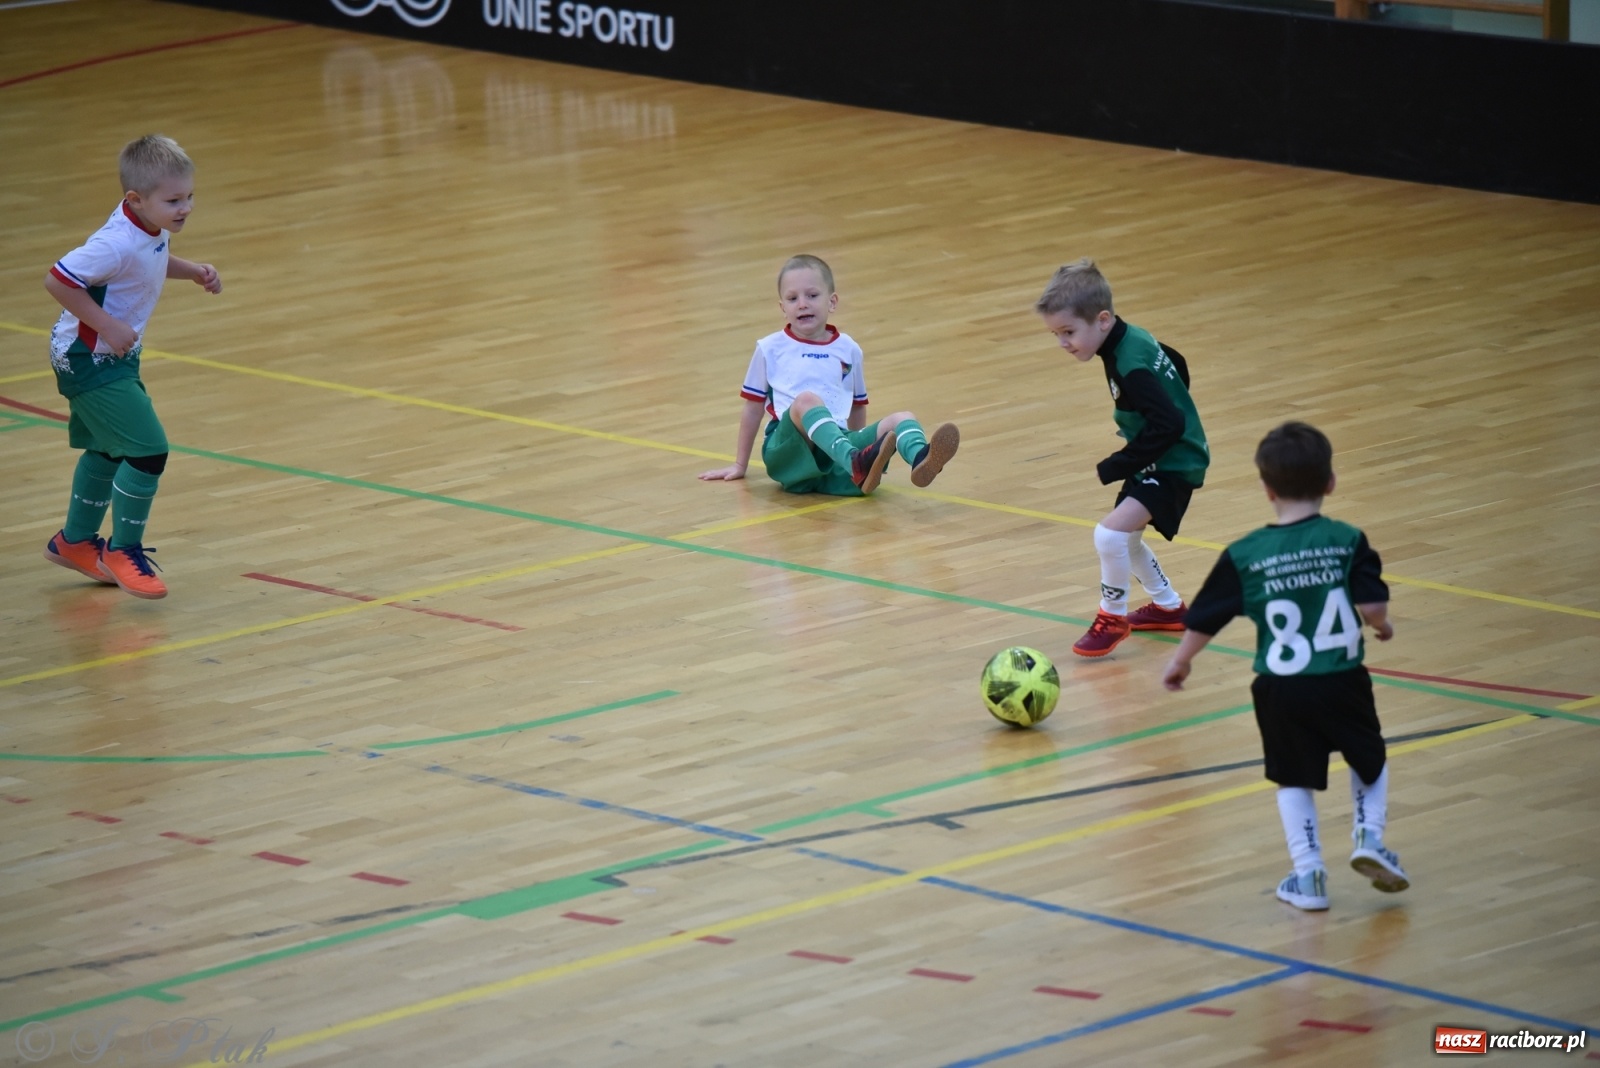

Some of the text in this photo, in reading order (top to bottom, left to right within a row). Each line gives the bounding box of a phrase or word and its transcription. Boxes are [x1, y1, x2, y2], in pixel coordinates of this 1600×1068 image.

[482, 0, 674, 51] UNIE SPORTU
[1263, 567, 1344, 595] TWORKÓW
[1265, 587, 1362, 676] 84
